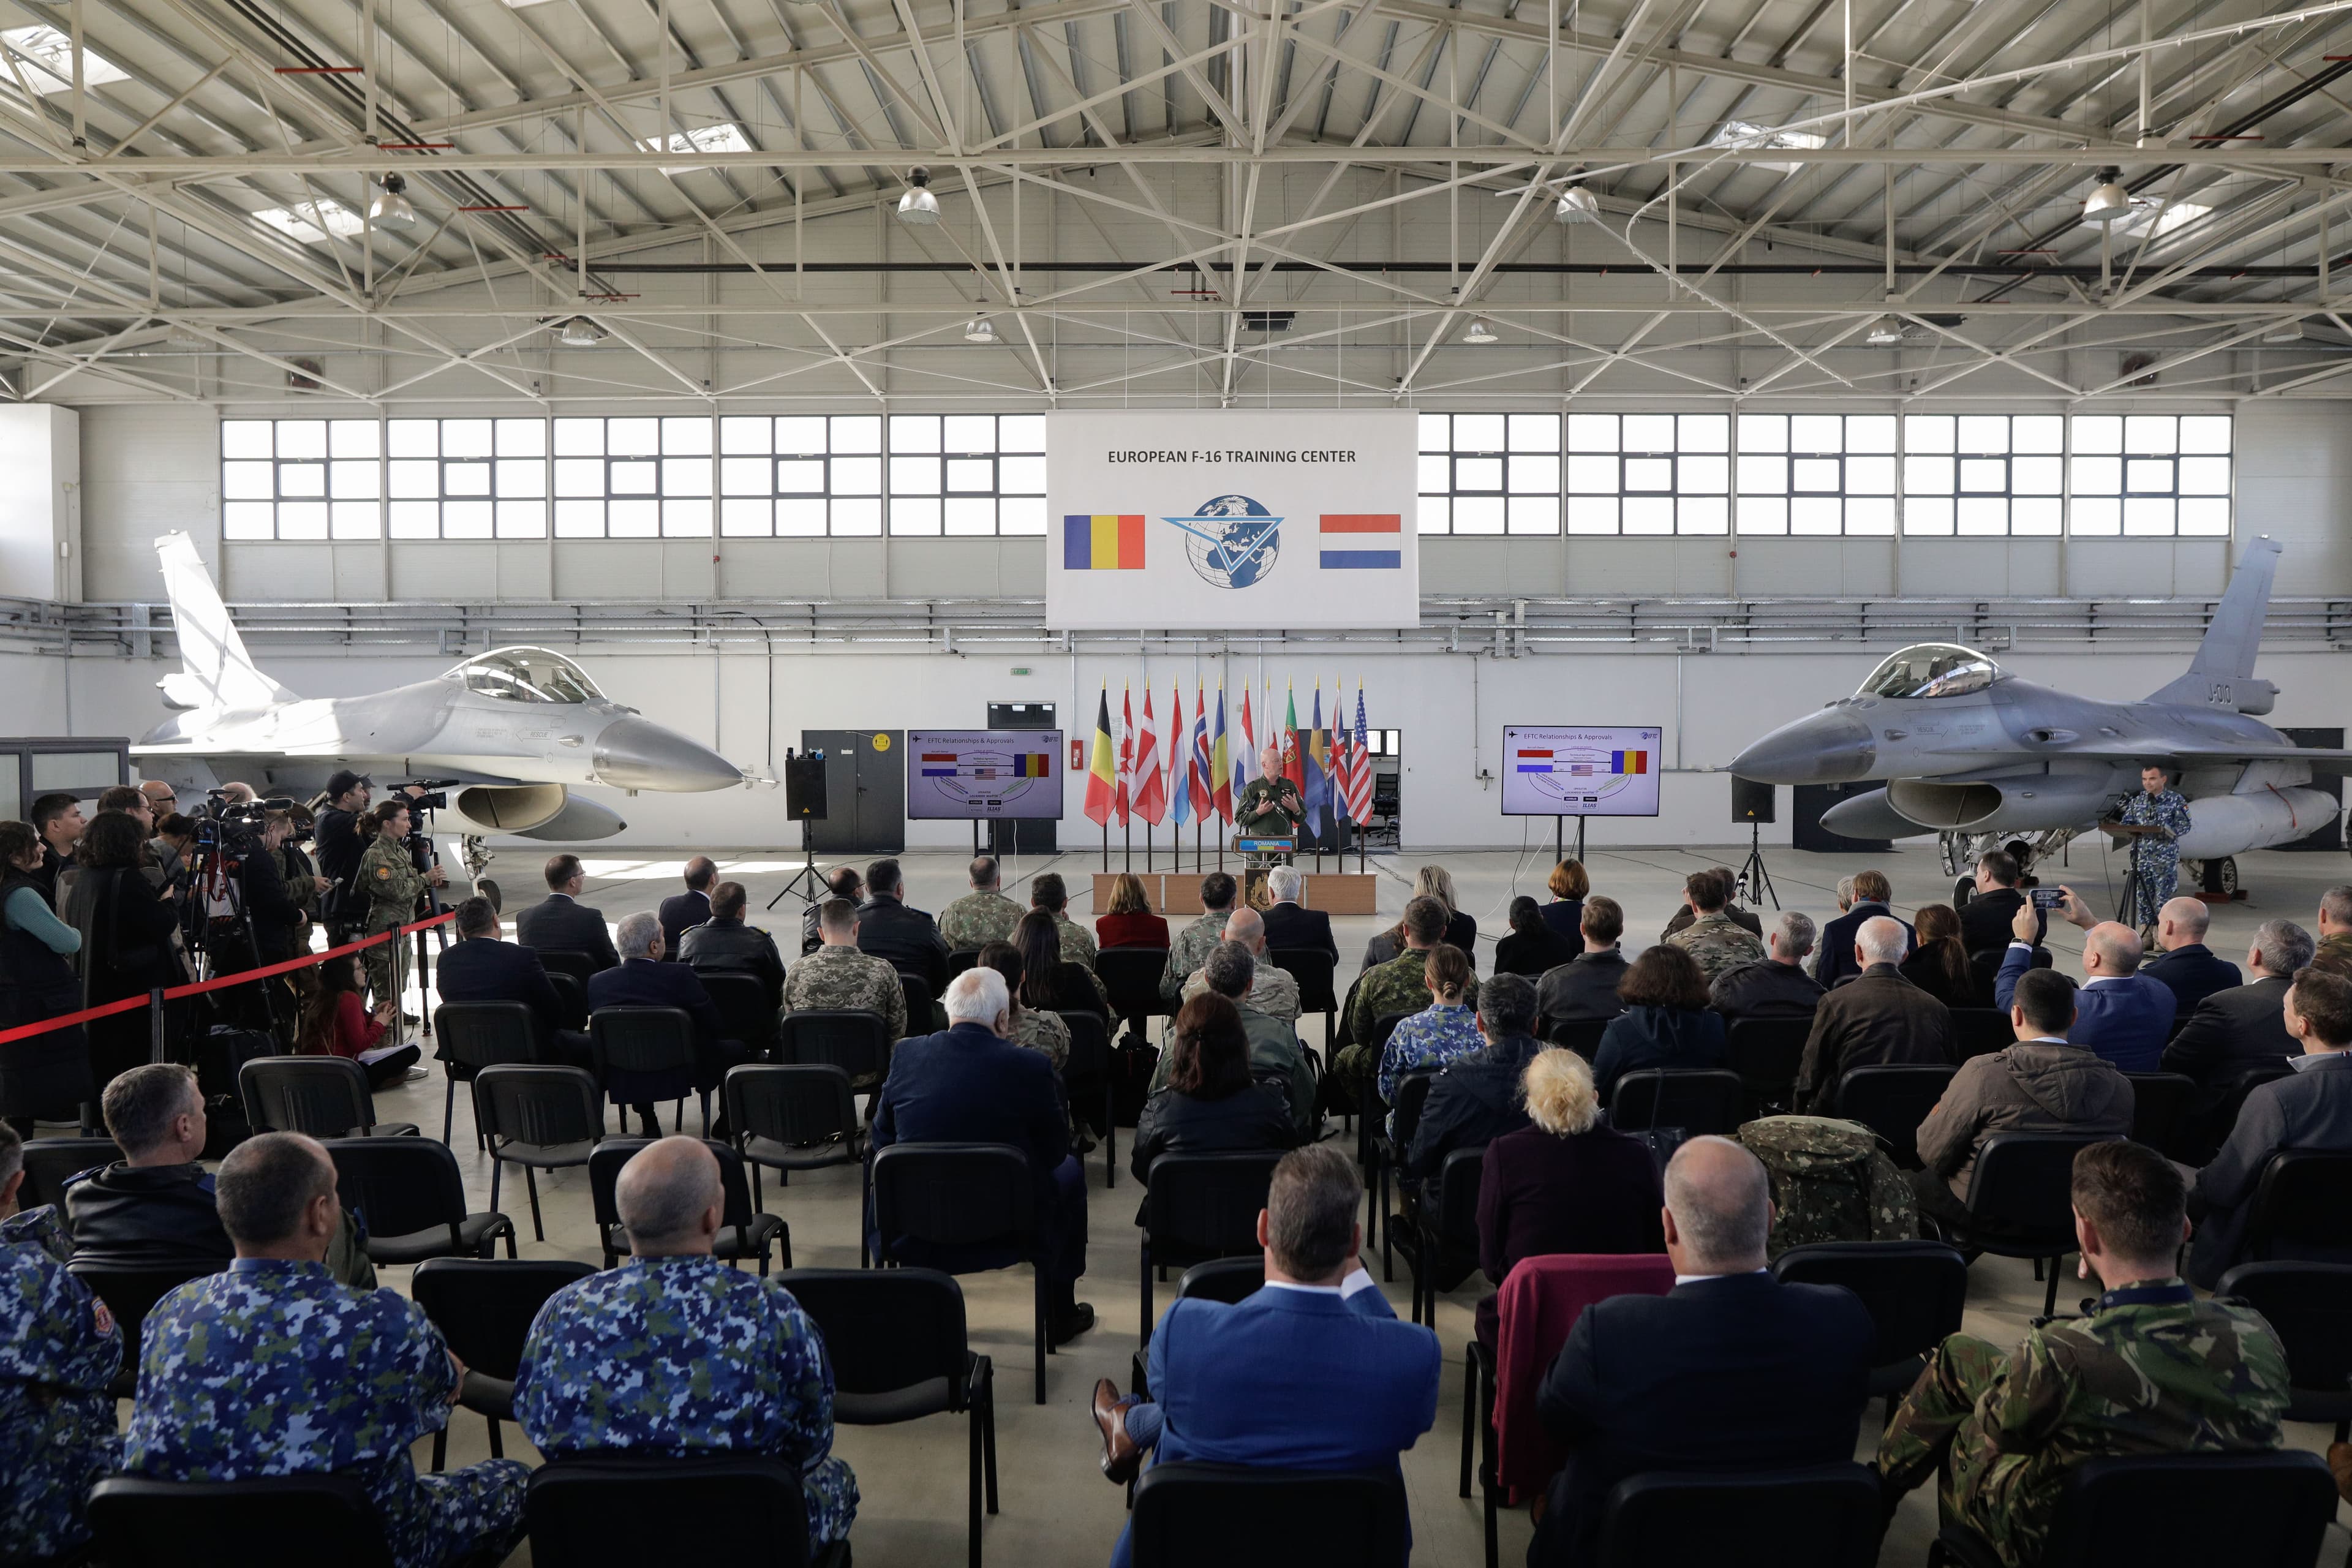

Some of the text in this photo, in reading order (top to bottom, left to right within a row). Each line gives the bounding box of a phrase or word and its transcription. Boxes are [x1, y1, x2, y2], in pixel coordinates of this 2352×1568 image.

[1108, 451, 1356, 463] EUROPEAN F-16 TRAINING CENTER
[2208, 684, 2233, 704] J-010
